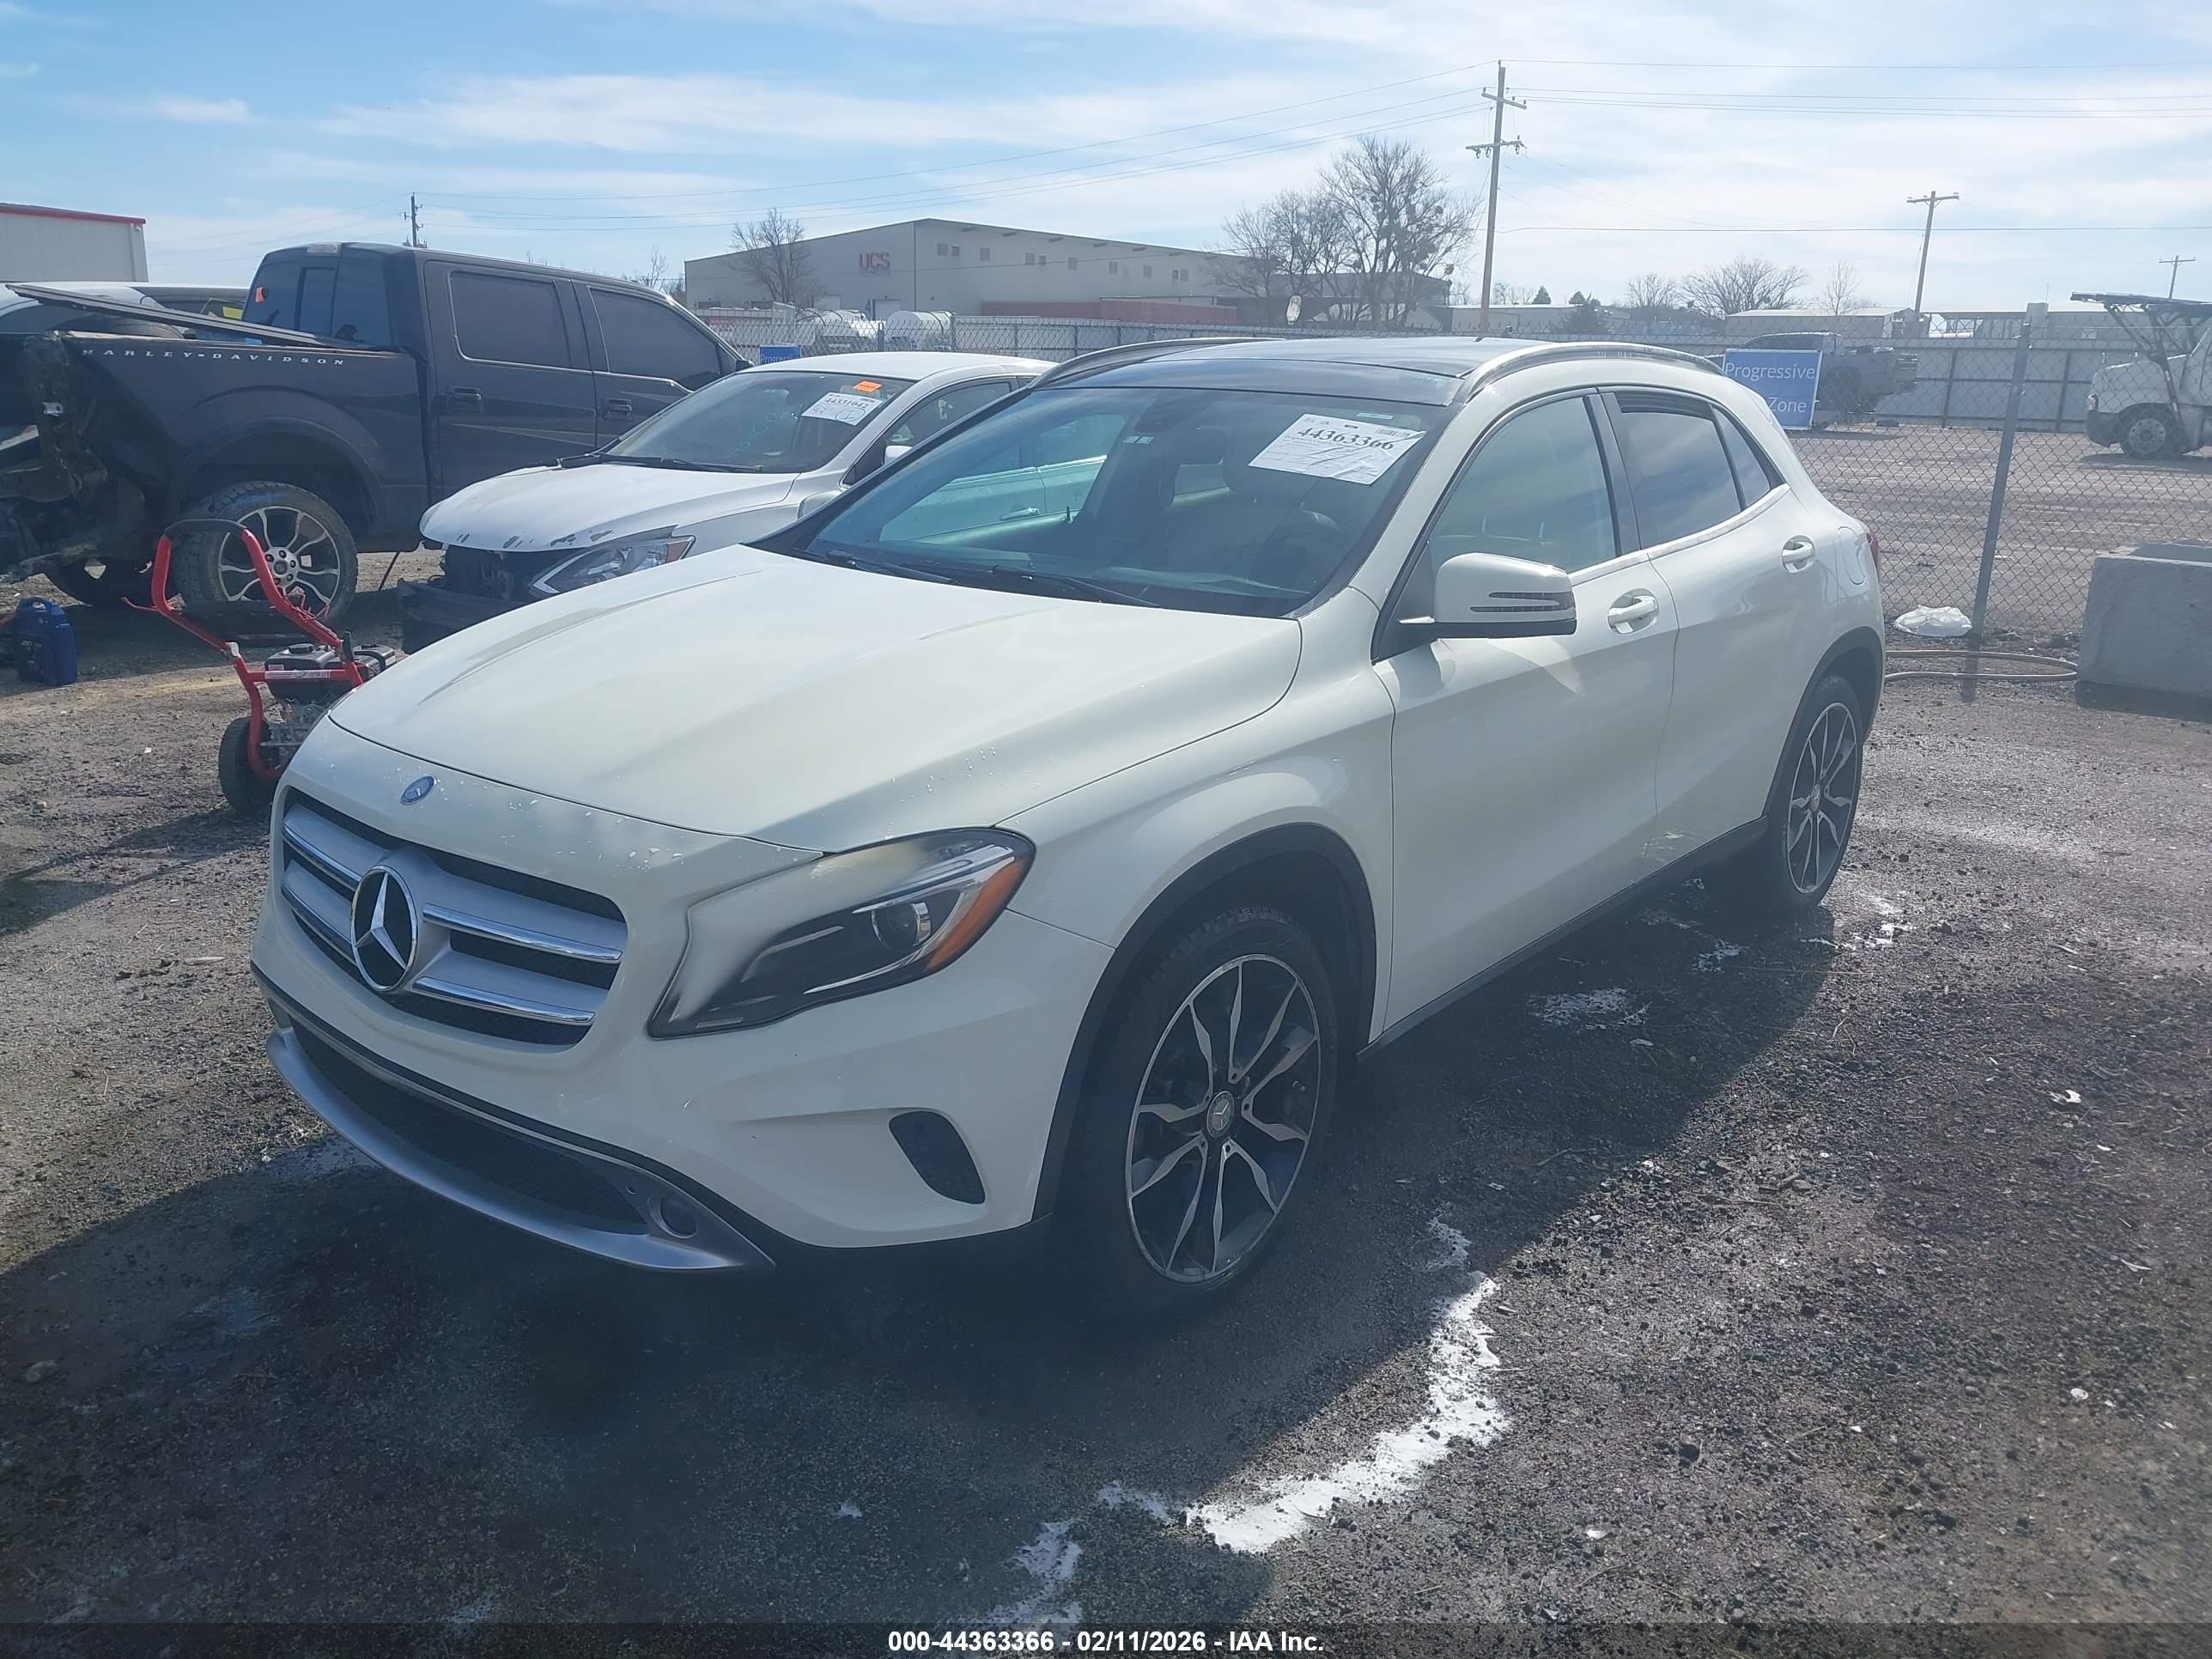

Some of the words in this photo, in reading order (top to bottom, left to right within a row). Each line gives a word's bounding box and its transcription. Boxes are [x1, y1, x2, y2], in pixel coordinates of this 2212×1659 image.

[860, 252, 890, 270] UCS
[82, 349, 344, 365] HARLEY-DAVIDSON
[1725, 362, 1815, 381] Progressive
[1767, 397, 1807, 413] Zone
[1297, 427, 1395, 451] 44363366
